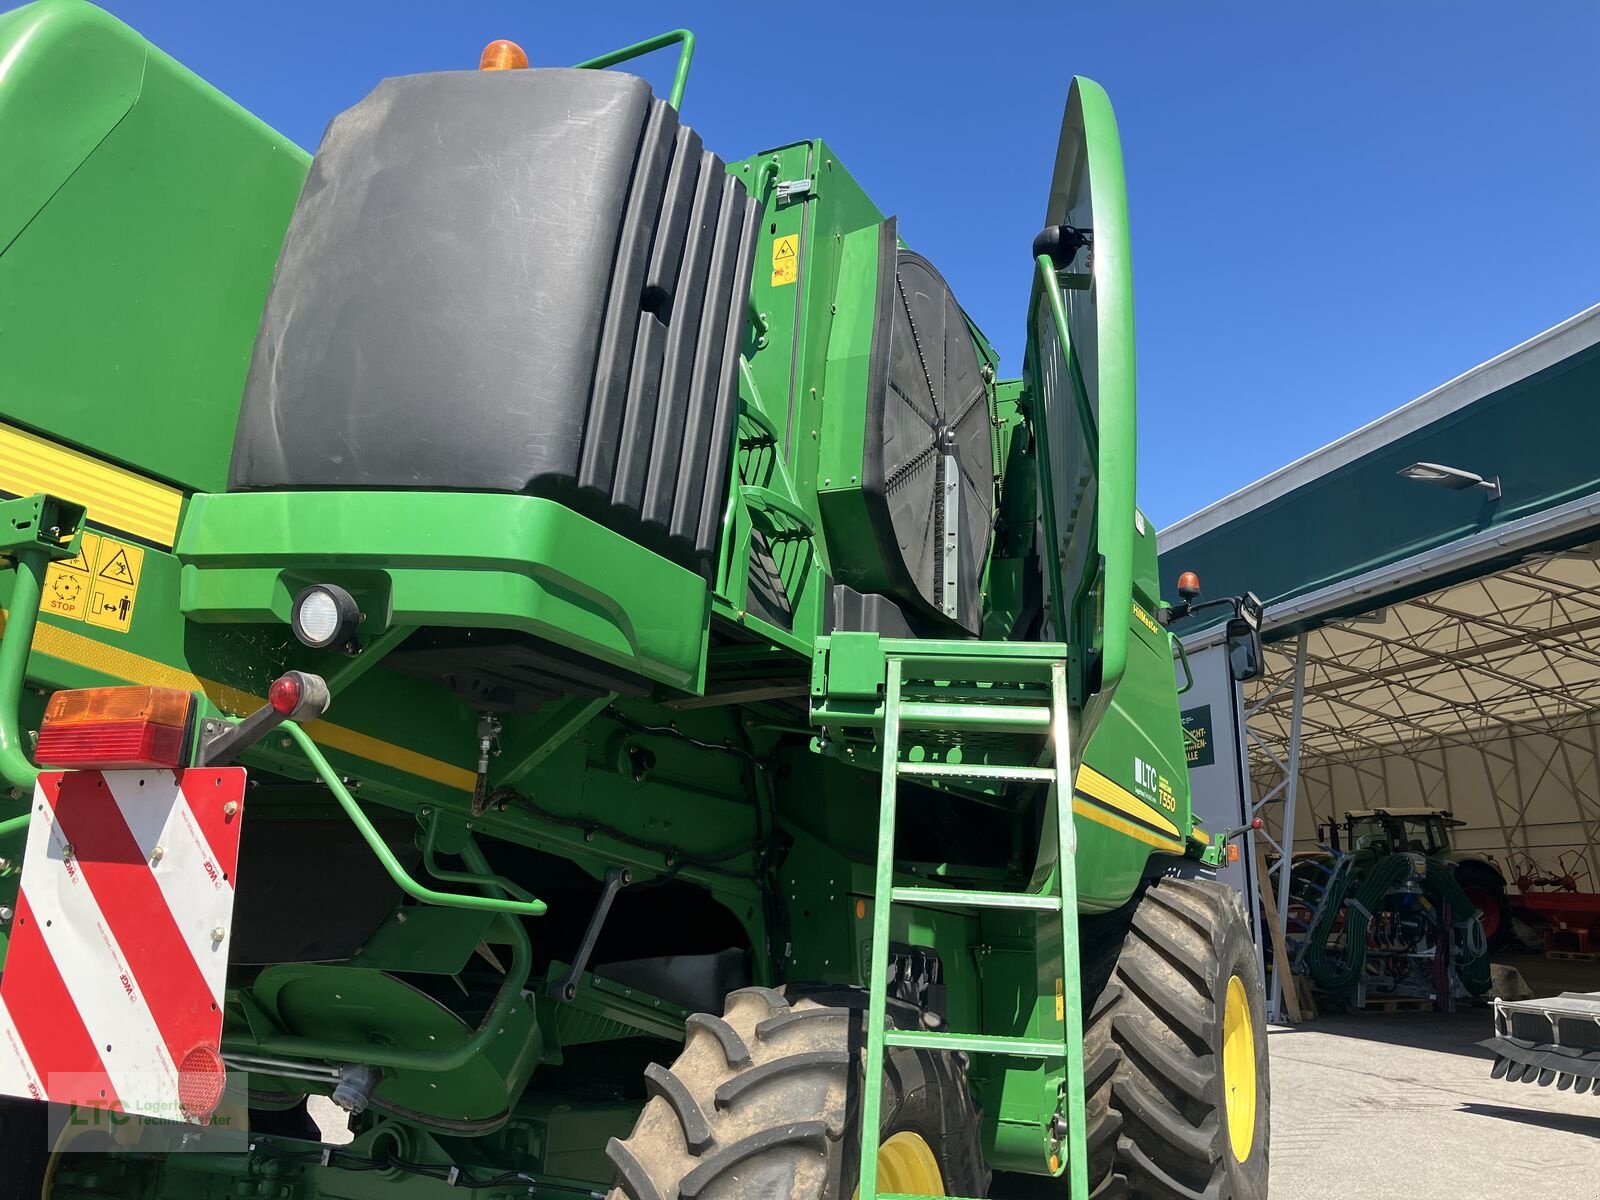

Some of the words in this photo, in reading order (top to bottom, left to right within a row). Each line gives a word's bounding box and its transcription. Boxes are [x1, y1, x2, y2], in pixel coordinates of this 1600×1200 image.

[50, 600, 76, 612] STOP
[1142, 761, 1157, 793] LTC
[1159, 788, 1176, 813] T550
[203, 860, 218, 883] WGF
[119, 973, 134, 995] WGF
